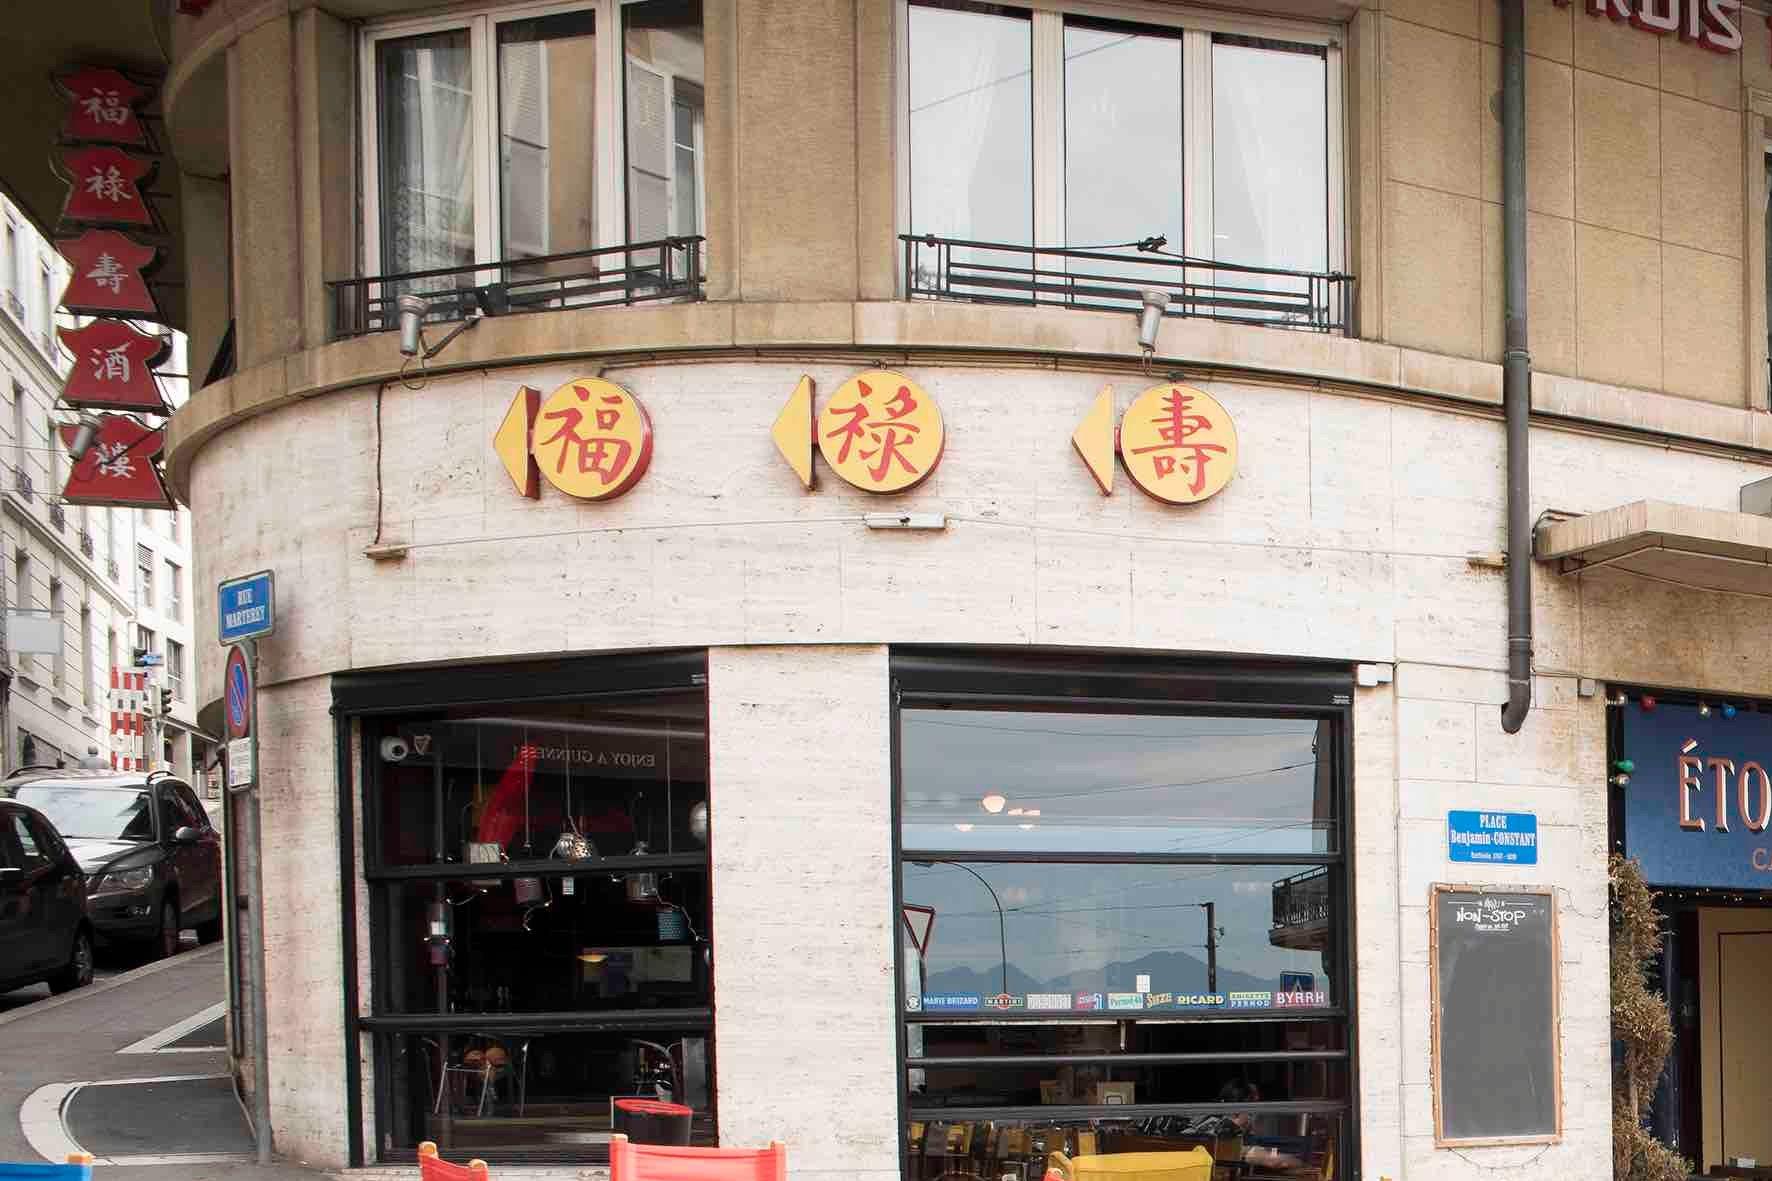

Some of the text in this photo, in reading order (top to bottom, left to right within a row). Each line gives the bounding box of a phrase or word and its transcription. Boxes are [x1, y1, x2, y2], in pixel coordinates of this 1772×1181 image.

[540, 386, 631, 484] 福
[1130, 389, 1228, 496] 壽
[238, 588, 253, 606] RUE
[1480, 814, 1507, 829] PLACE
[1456, 906, 1527, 925] NON-STOP
[1177, 995, 1224, 1005] RICARD
[1231, 1000, 1270, 1008] PERNOD
[1277, 992, 1324, 1003] BYRRH
